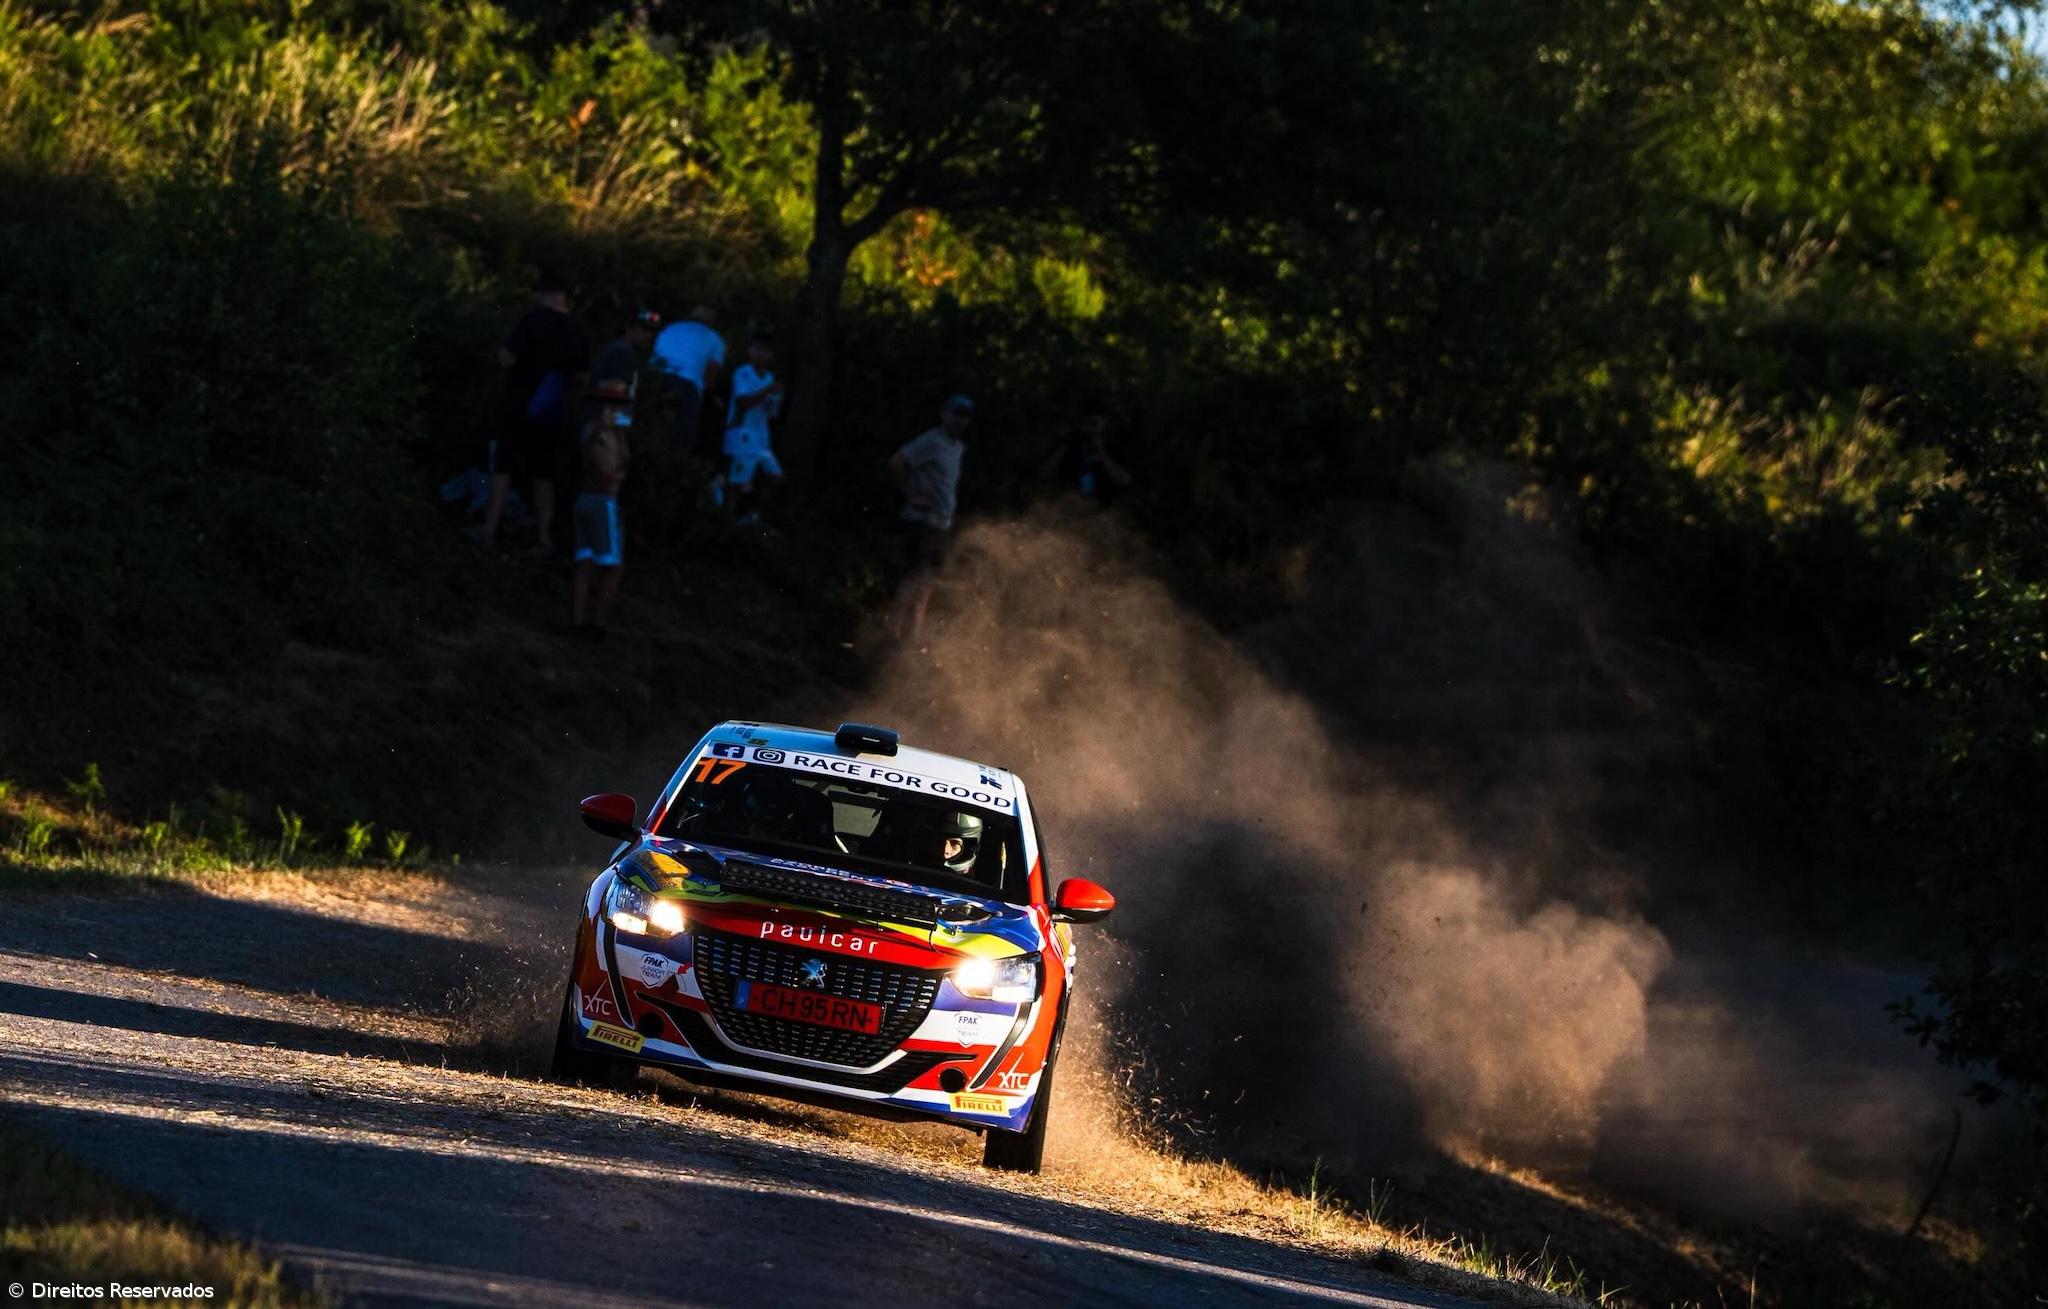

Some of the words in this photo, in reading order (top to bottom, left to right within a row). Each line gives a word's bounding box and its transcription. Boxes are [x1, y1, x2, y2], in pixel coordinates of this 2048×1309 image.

[695, 757, 748, 785] 17
[794, 755, 861, 776] RACE
[870, 768, 921, 788] FOR
[930, 782, 1011, 808] GOOD
[644, 956, 664, 967] FPAK
[641, 970, 661, 979] TEAM
[584, 978, 612, 1016] XTC
[958, 1016, 978, 1024] FPAK
[593, 1024, 640, 1048] PIRELLI
[998, 1053, 1029, 1089] XTC
[955, 1096, 1002, 1111] PIRELLI
